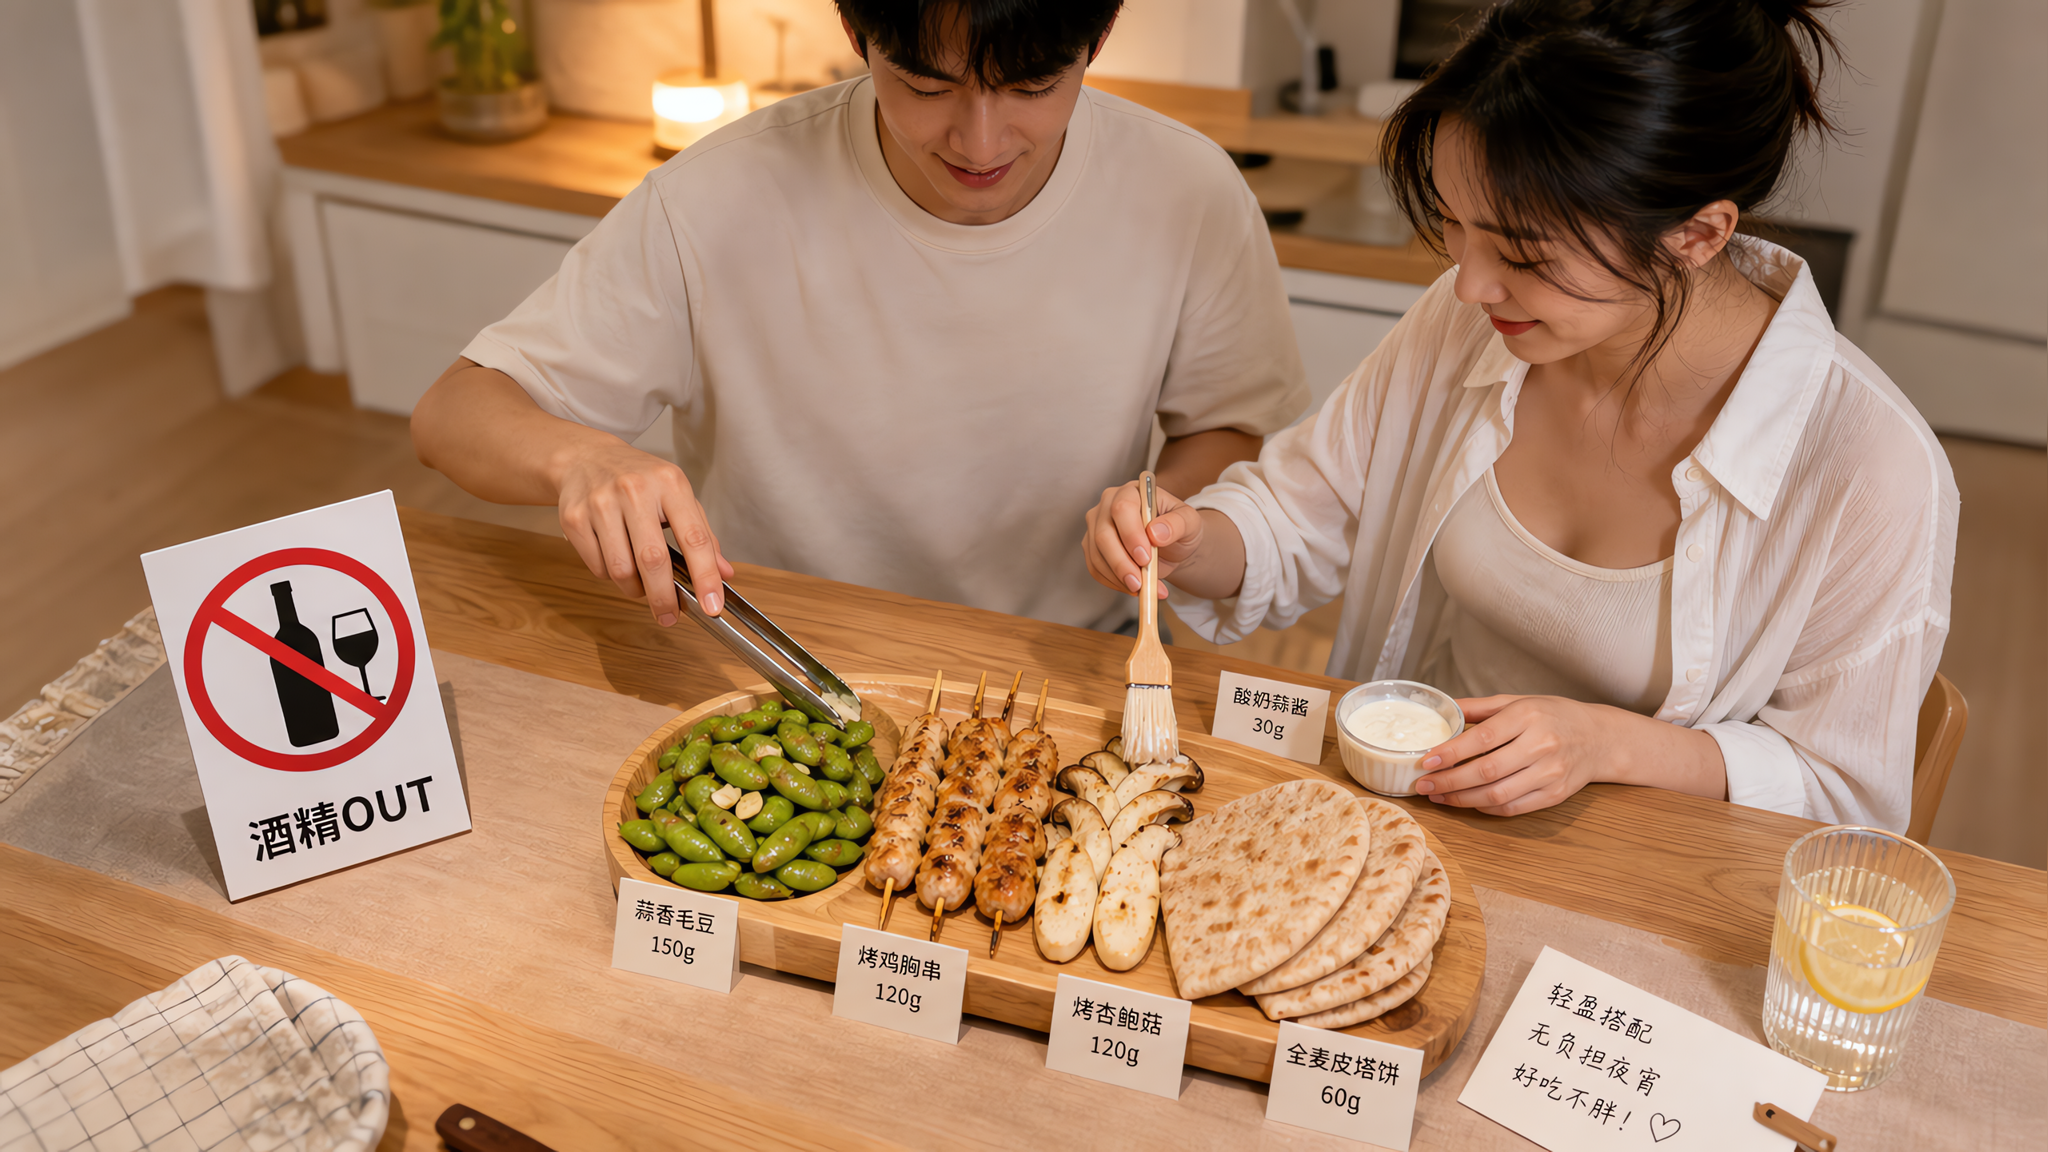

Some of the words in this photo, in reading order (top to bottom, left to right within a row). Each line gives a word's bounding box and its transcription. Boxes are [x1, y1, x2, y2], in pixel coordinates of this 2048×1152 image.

[1233, 687, 1309, 717] 酸奶蒜酱
[1252, 717, 1285, 740] 30g
[248, 775, 433, 863] 酒精OUT
[634, 899, 715, 935] 蒜香毛豆
[651, 935, 696, 965] 150g
[857, 945, 941, 982] 烤鸡胸串
[875, 983, 922, 1013] 120g
[1072, 996, 1163, 1036] 烤杏鲍菇
[1546, 982, 1654, 1045] 轻盈搭配
[1090, 1035, 1140, 1068] 120g
[1286, 1042, 1400, 1086] 全麦皮塔饼
[1527, 1022, 1661, 1097] 无负担夜宵
[1321, 1085, 1361, 1115] 60g
